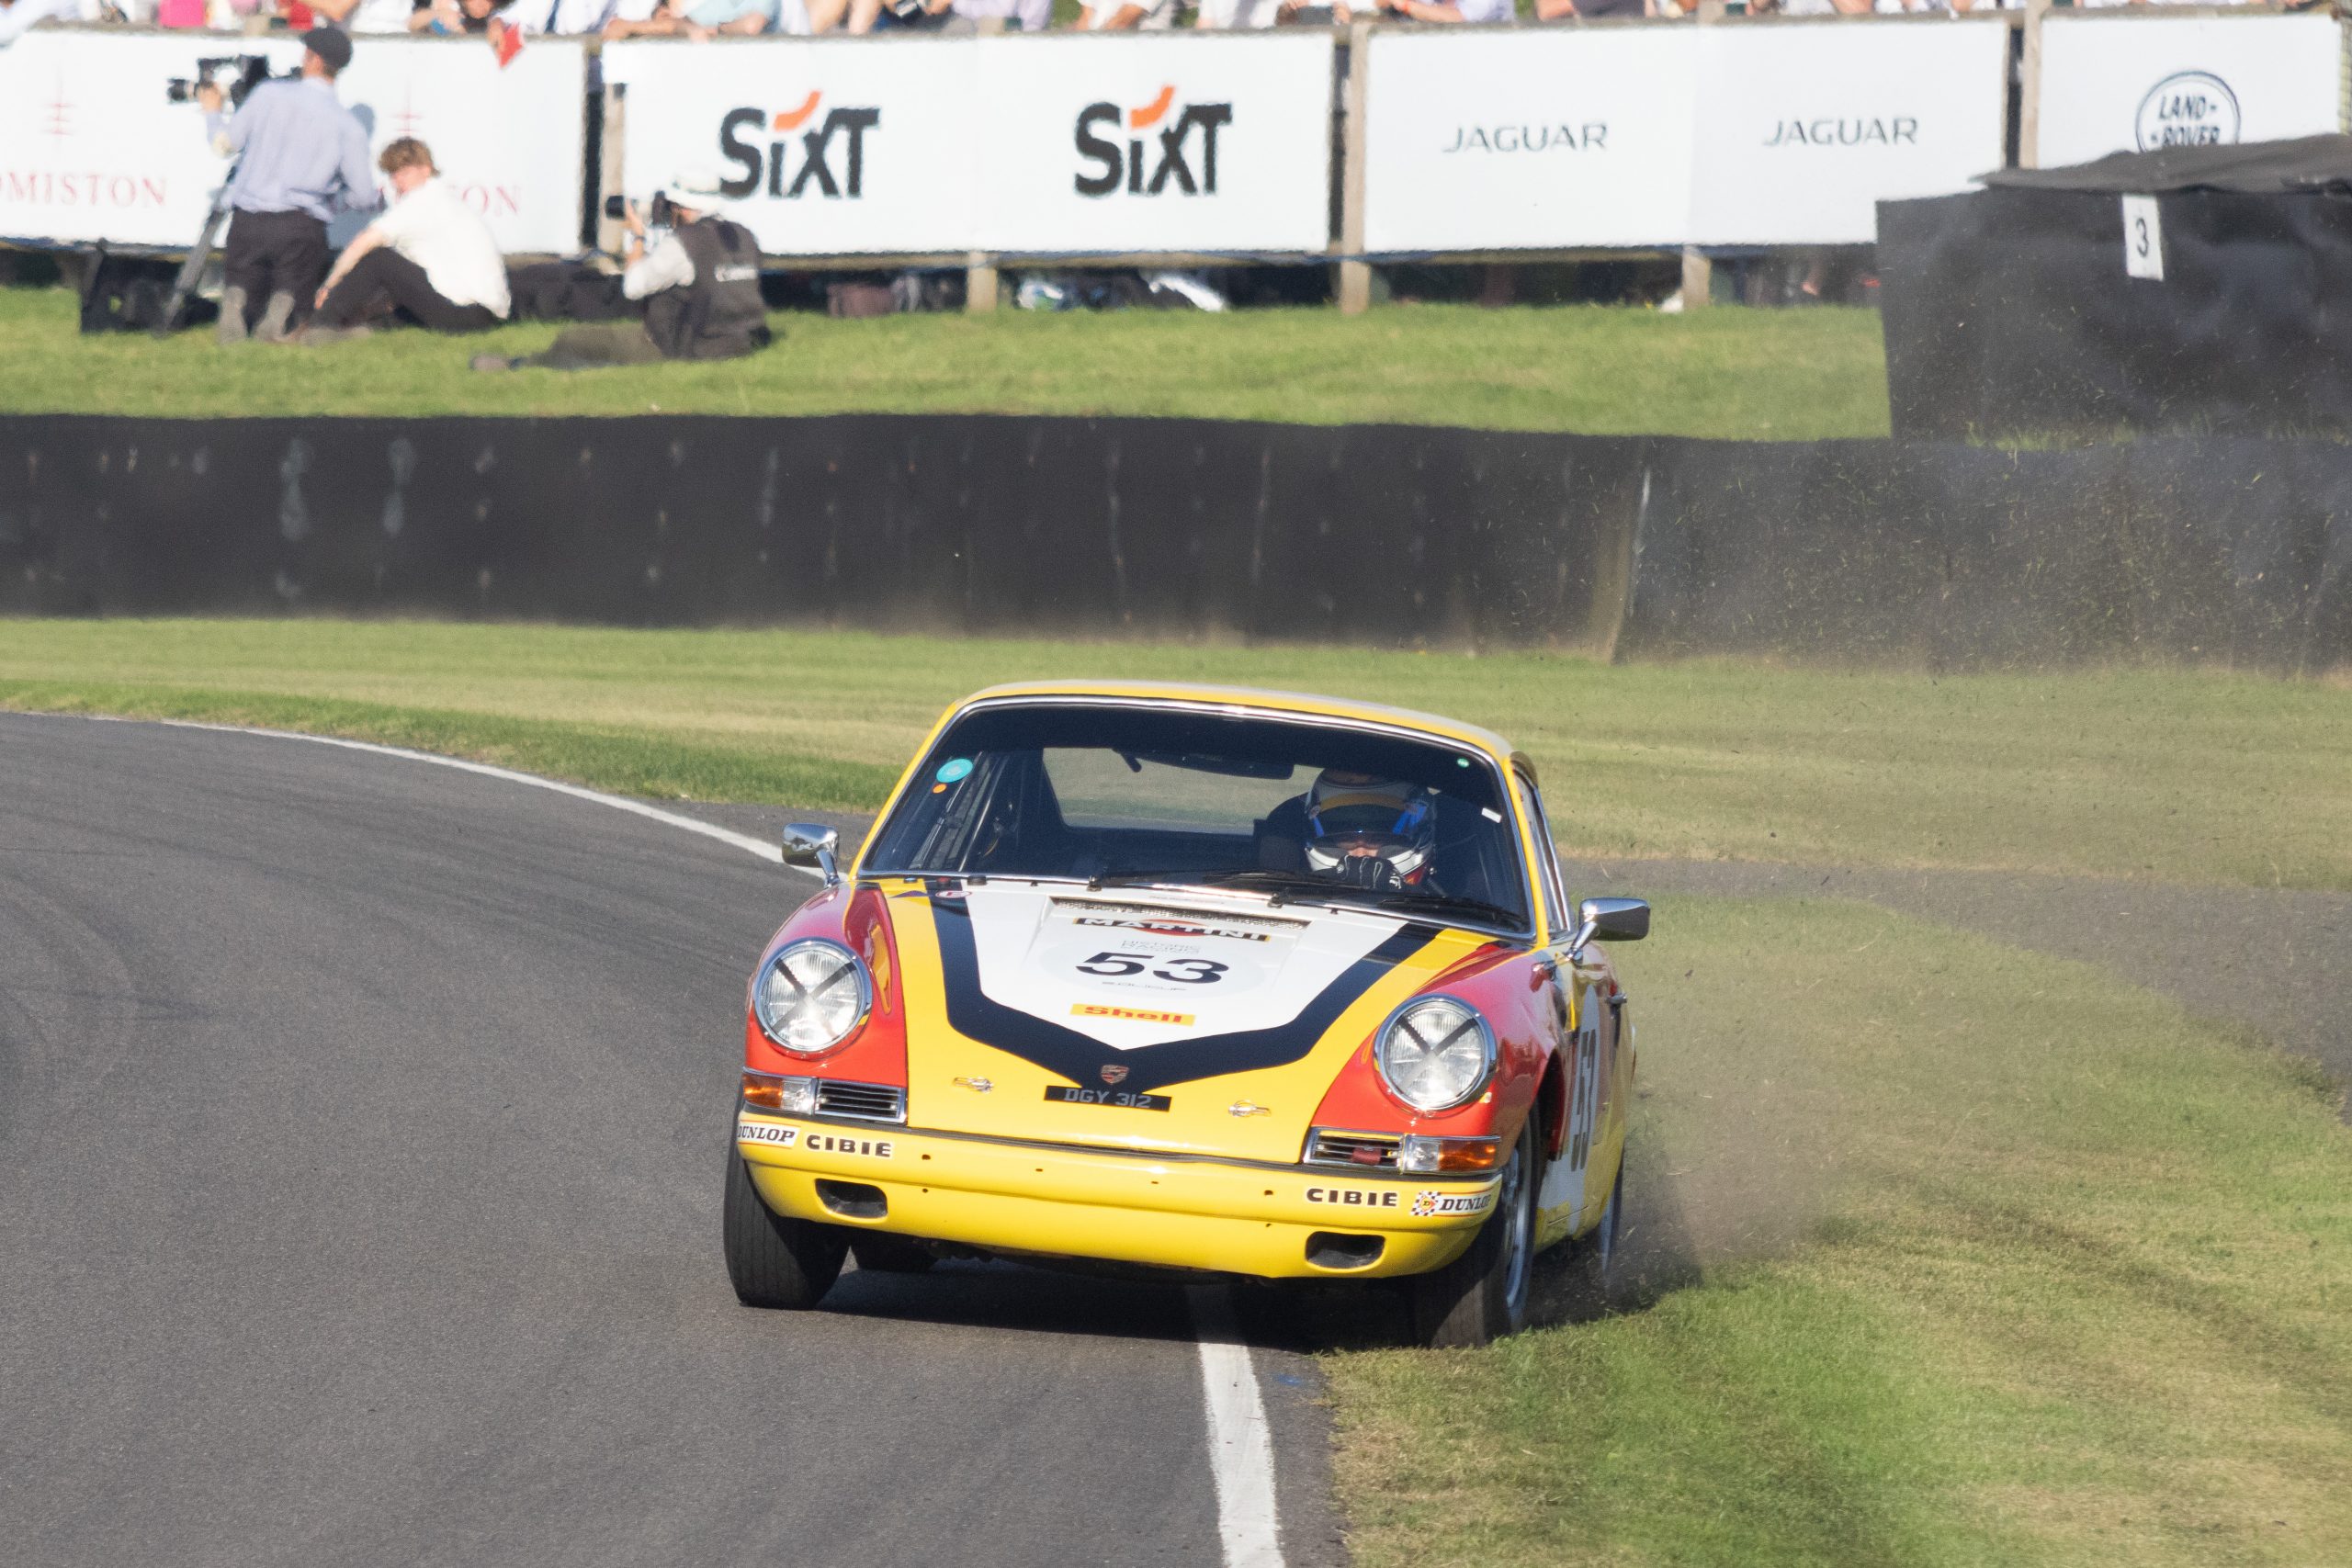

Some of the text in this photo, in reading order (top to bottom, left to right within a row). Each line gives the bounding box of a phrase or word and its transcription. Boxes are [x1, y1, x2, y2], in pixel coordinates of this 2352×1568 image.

[1442, 123, 1608, 153] JAGUAR
[1762, 118, 1918, 147] JAGUAR
[0, 171, 169, 209] MISTON
[2135, 217, 2149, 258] 3
[1083, 918, 1262, 941] MARTINI
[1076, 952, 1229, 984] 53
[1084, 1006, 1182, 1023] Shell
[1063, 1088, 1154, 1109] DGY 312
[806, 1134, 892, 1157] CIBIE
[1306, 1188, 1398, 1207] CIBIE
